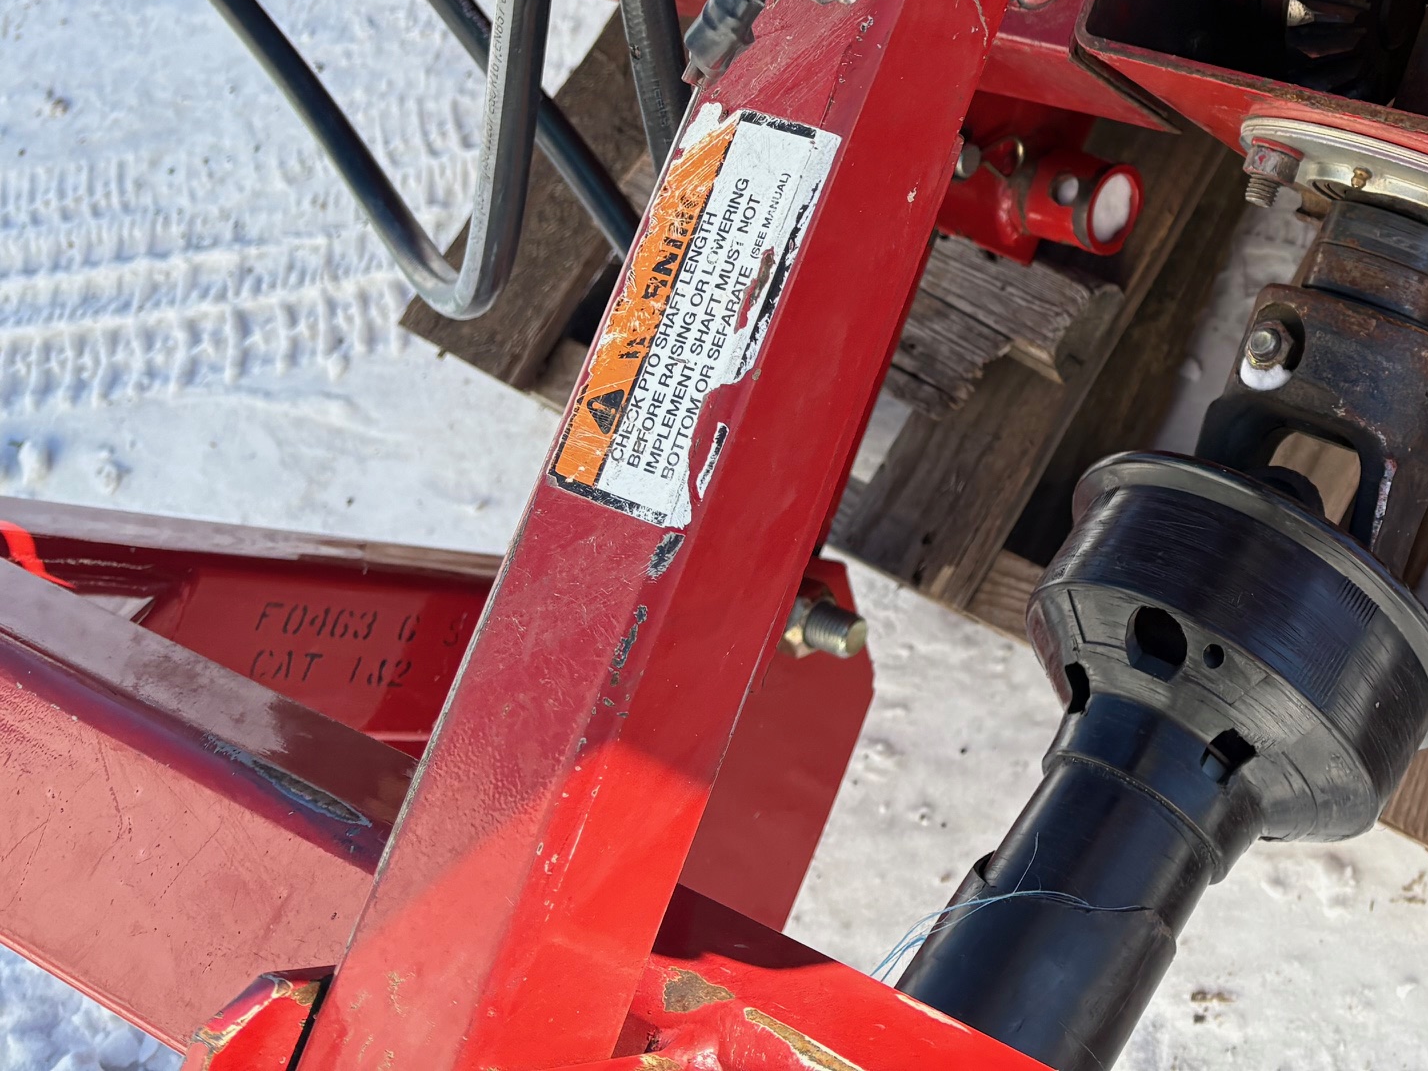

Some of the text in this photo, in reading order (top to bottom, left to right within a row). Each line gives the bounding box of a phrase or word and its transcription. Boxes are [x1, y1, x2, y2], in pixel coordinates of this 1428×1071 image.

[608, 210, 717, 463] CHECK PTO SHAFT LENGTH
[625, 174, 751, 469] BEFORE RAISING OR LOWERING
[642, 357, 698, 475] IMPLEMENT.
[688, 294, 722, 357] SHAFT
[736, 192, 762, 234] NOT
[659, 170, 792, 482] BOTTOM OR SEPARATE (SEE MANUAL)
[250, 650, 324, 681] CAT
